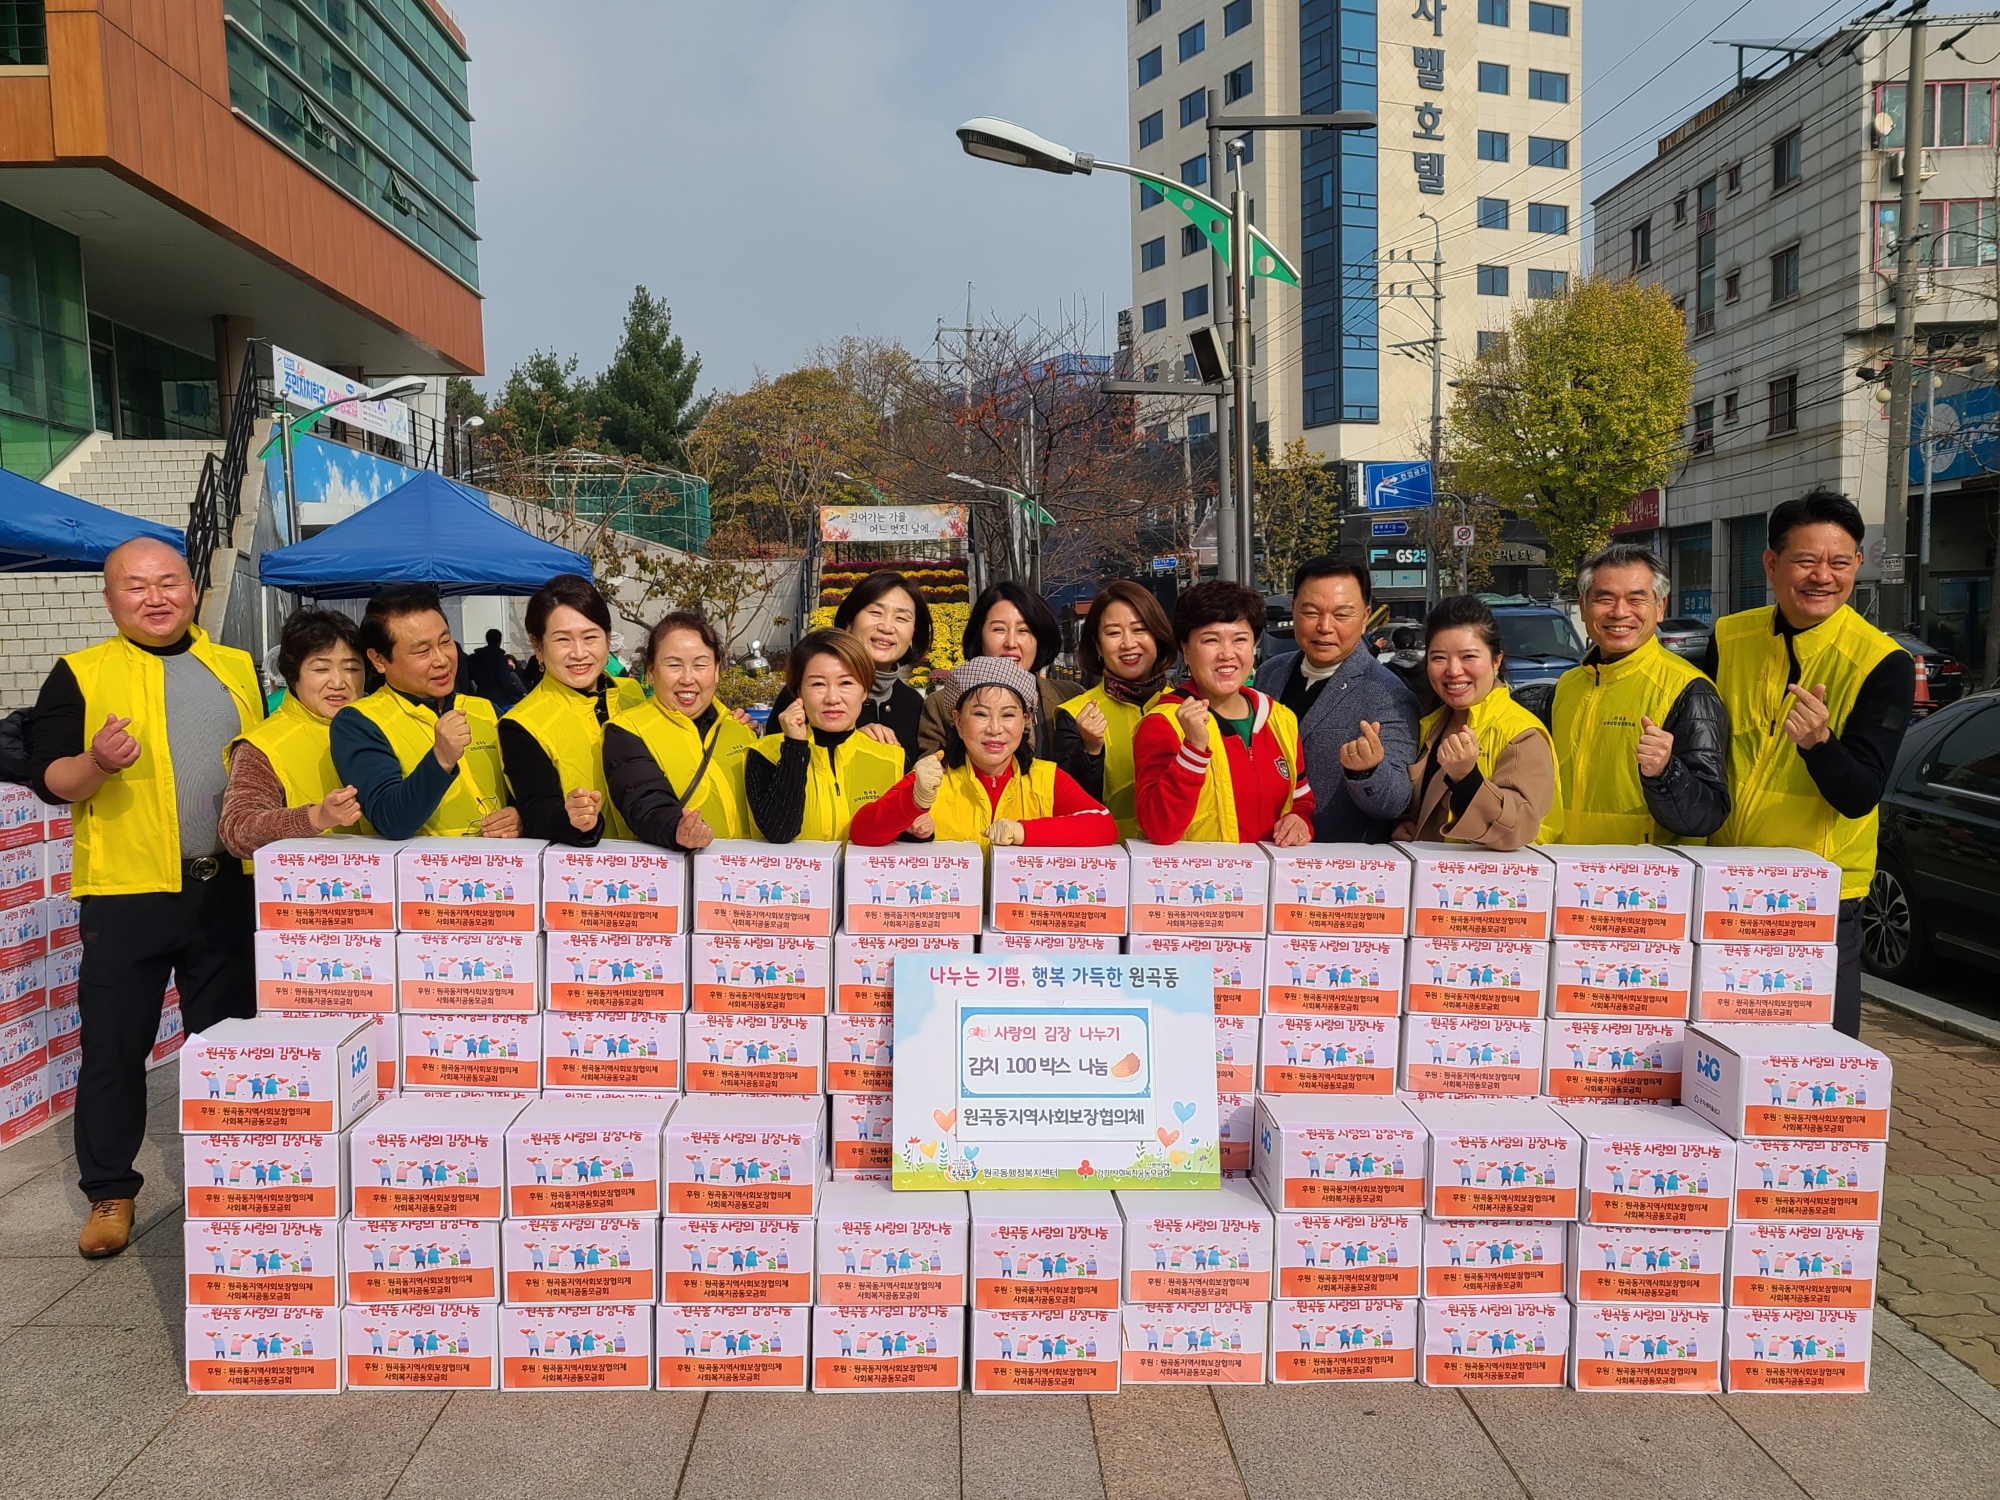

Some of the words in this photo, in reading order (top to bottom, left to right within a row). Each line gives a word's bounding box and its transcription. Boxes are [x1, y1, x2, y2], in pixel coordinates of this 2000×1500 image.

[284, 370, 326, 405] 주민자치학교
[1400, 466, 1427, 480] 진입금지
[850, 513, 886, 523] 깊어가는
[889, 512, 907, 522] 가을
[869, 526, 888, 535] 어느
[890, 524, 908, 535] 멋진
[1396, 549, 1426, 563] GS25
[276, 853, 306, 866] 원곡동
[307, 853, 338, 866] 사랑의
[340, 853, 381, 866] 김장나눔
[420, 853, 450, 866] 원곡동
[450, 854, 482, 867] 사랑의
[483, 854, 524, 867] 김장나눔
[565, 853, 595, 867] 원곡동
[596, 854, 627, 868] 사랑의
[629, 855, 669, 869] 김장나눔
[868, 855, 897, 869] 원곡동
[898, 856, 929, 869] 사랑의
[930, 856, 970, 869] 김장나눔
[1016, 855, 1045, 868] 원곡동
[1046, 856, 1076, 869] 사랑의
[1078, 856, 1117, 870] 김장나눔
[1437, 861, 1466, 874] 원곡동
[1467, 862, 1498, 875] 사랑의
[1499, 862, 1540, 876] 김장나눔
[275, 908, 289, 916] 후원
[295, 908, 374, 916] 원곡동지역사회보장협의체
[560, 908, 574, 917] 후원
[580, 909, 658, 919] 원곡동지역사회보장협의체
[1010, 909, 1024, 917] 후원
[1030, 910, 1107, 920] 원곡동지역사회보장협의체
[294, 917, 354, 925] 사회복지공동모금회
[436, 918, 495, 926] 사회복지공동모금회
[579, 918, 638, 928] 사회복지공동모금회
[882, 920, 940, 928] 사회복지공동모금회
[1029, 919, 1086, 928] 사회복지공동모금회
[1430, 915, 1444, 923] 후원
[1450, 915, 1527, 925] 원곡동지역사회보장협의체
[1448, 924, 1507, 933] 사회복지공동모금회
[1289, 938, 1318, 952] 원곡동
[1319, 939, 1349, 953] 사랑의
[1351, 940, 1391, 954] 김장나눔
[930, 966, 980, 987] 나누는
[987, 966, 1026, 988] 기쁨,
[1032, 966, 1066, 988] 행복
[1072, 966, 1123, 988] 가득한
[1129, 967, 1179, 988] 원곡동
[1302, 1002, 1359, 1011] 사회복지공동모금회
[1284, 1018, 1313, 1031] 원곡동
[1314, 1019, 1344, 1031] 사랑의
[1346, 1019, 1385, 1032] 김장나눔
[994, 1027, 1036, 1042] 사랑의
[1044, 1027, 1071, 1042] 김장
[1080, 1027, 1120, 1042] 나누기
[205, 1046, 238, 1060] 원곡동
[239, 1046, 274, 1060] 사랑의
[276, 1046, 322, 1061] 김장나눔
[352, 1046, 368, 1078] MG
[968, 1057, 998, 1076] 김치
[1079, 1057, 1108, 1076] 나눔
[1697, 1050, 1720, 1081] MG
[1769, 1053, 1800, 1068] 원곡동
[1801, 1055, 1835, 1069] 사랑의
[1836, 1055, 1880, 1070] 김장나눔
[1298, 1081, 1355, 1090] 사회복지공동모금회
[200, 1107, 216, 1115] 후원
[222, 1107, 310, 1116] 원곡동지역사회보장협의체
[964, 1108, 1144, 1126] 원곡동지역사회보장협의체
[221, 1117, 287, 1126] 사회복지공동모금회
[1762, 1113, 1777, 1121] 후원
[1783, 1113, 1866, 1124] 원곡동지역사회보장협의체
[1782, 1123, 1844, 1133] 사회복지공동모금회
[376, 1133, 408, 1148] 원곡동
[409, 1134, 443, 1147] 사랑의
[445, 1133, 490, 1147] 김장나눔
[1458, 1135, 1489, 1149] 원곡동
[1490, 1135, 1523, 1149] 사랑의
[1525, 1136, 1568, 1150] 김장나눔
[984, 1168, 1058, 1178] 원곡동행정복지센터
[372, 1194, 387, 1202] 후원
[394, 1194, 480, 1202] 원곡동지역사회보장협의체
[1452, 1193, 1466, 1202] 후원
[1473, 1193, 1556, 1203] 원곡동지역사회보장협의체
[393, 1204, 457, 1212] 사회복지공동모금회
[1471, 1203, 1534, 1212] 사회복지공동모금회
[842, 1221, 873, 1235] 원곡동
[874, 1221, 907, 1235] 사랑의
[909, 1221, 953, 1235] 김장나눔
[1153, 1218, 1184, 1232] 원곡동
[1185, 1219, 1217, 1232] 사랑의
[1219, 1219, 1261, 1233] 김장나눔
[998, 1226, 1029, 1240] 원곡동
[1031, 1226, 1064, 1239] 사랑의
[1066, 1226, 1109, 1240] 김장나눔
[837, 1281, 851, 1290] 후원
[858, 1281, 942, 1290] 원곡동지역사회보장협의체
[1147, 1278, 1161, 1286] 후원
[1168, 1278, 1250, 1286] 원곡동지역사회보장협의체
[857, 1291, 920, 1300] 사회복지공동모금회
[993, 1286, 1007, 1294] 후원
[1014, 1286, 1098, 1294] 원곡동지역사회보장협의체
[1166, 1288, 1228, 1296] 사회복지공동모금회
[1013, 1296, 1076, 1304] 사회복지공동모금회
[1600, 1307, 1631, 1322] 원곡동
[1633, 1308, 1665, 1322] 사랑의
[1667, 1309, 1710, 1323] 김장나눔
[1595, 1367, 1610, 1375] 후원
[1616, 1367, 1697, 1376] 원곡동지역사회보장협의체
[1615, 1377, 1676, 1385] 사회복지공동모금회
